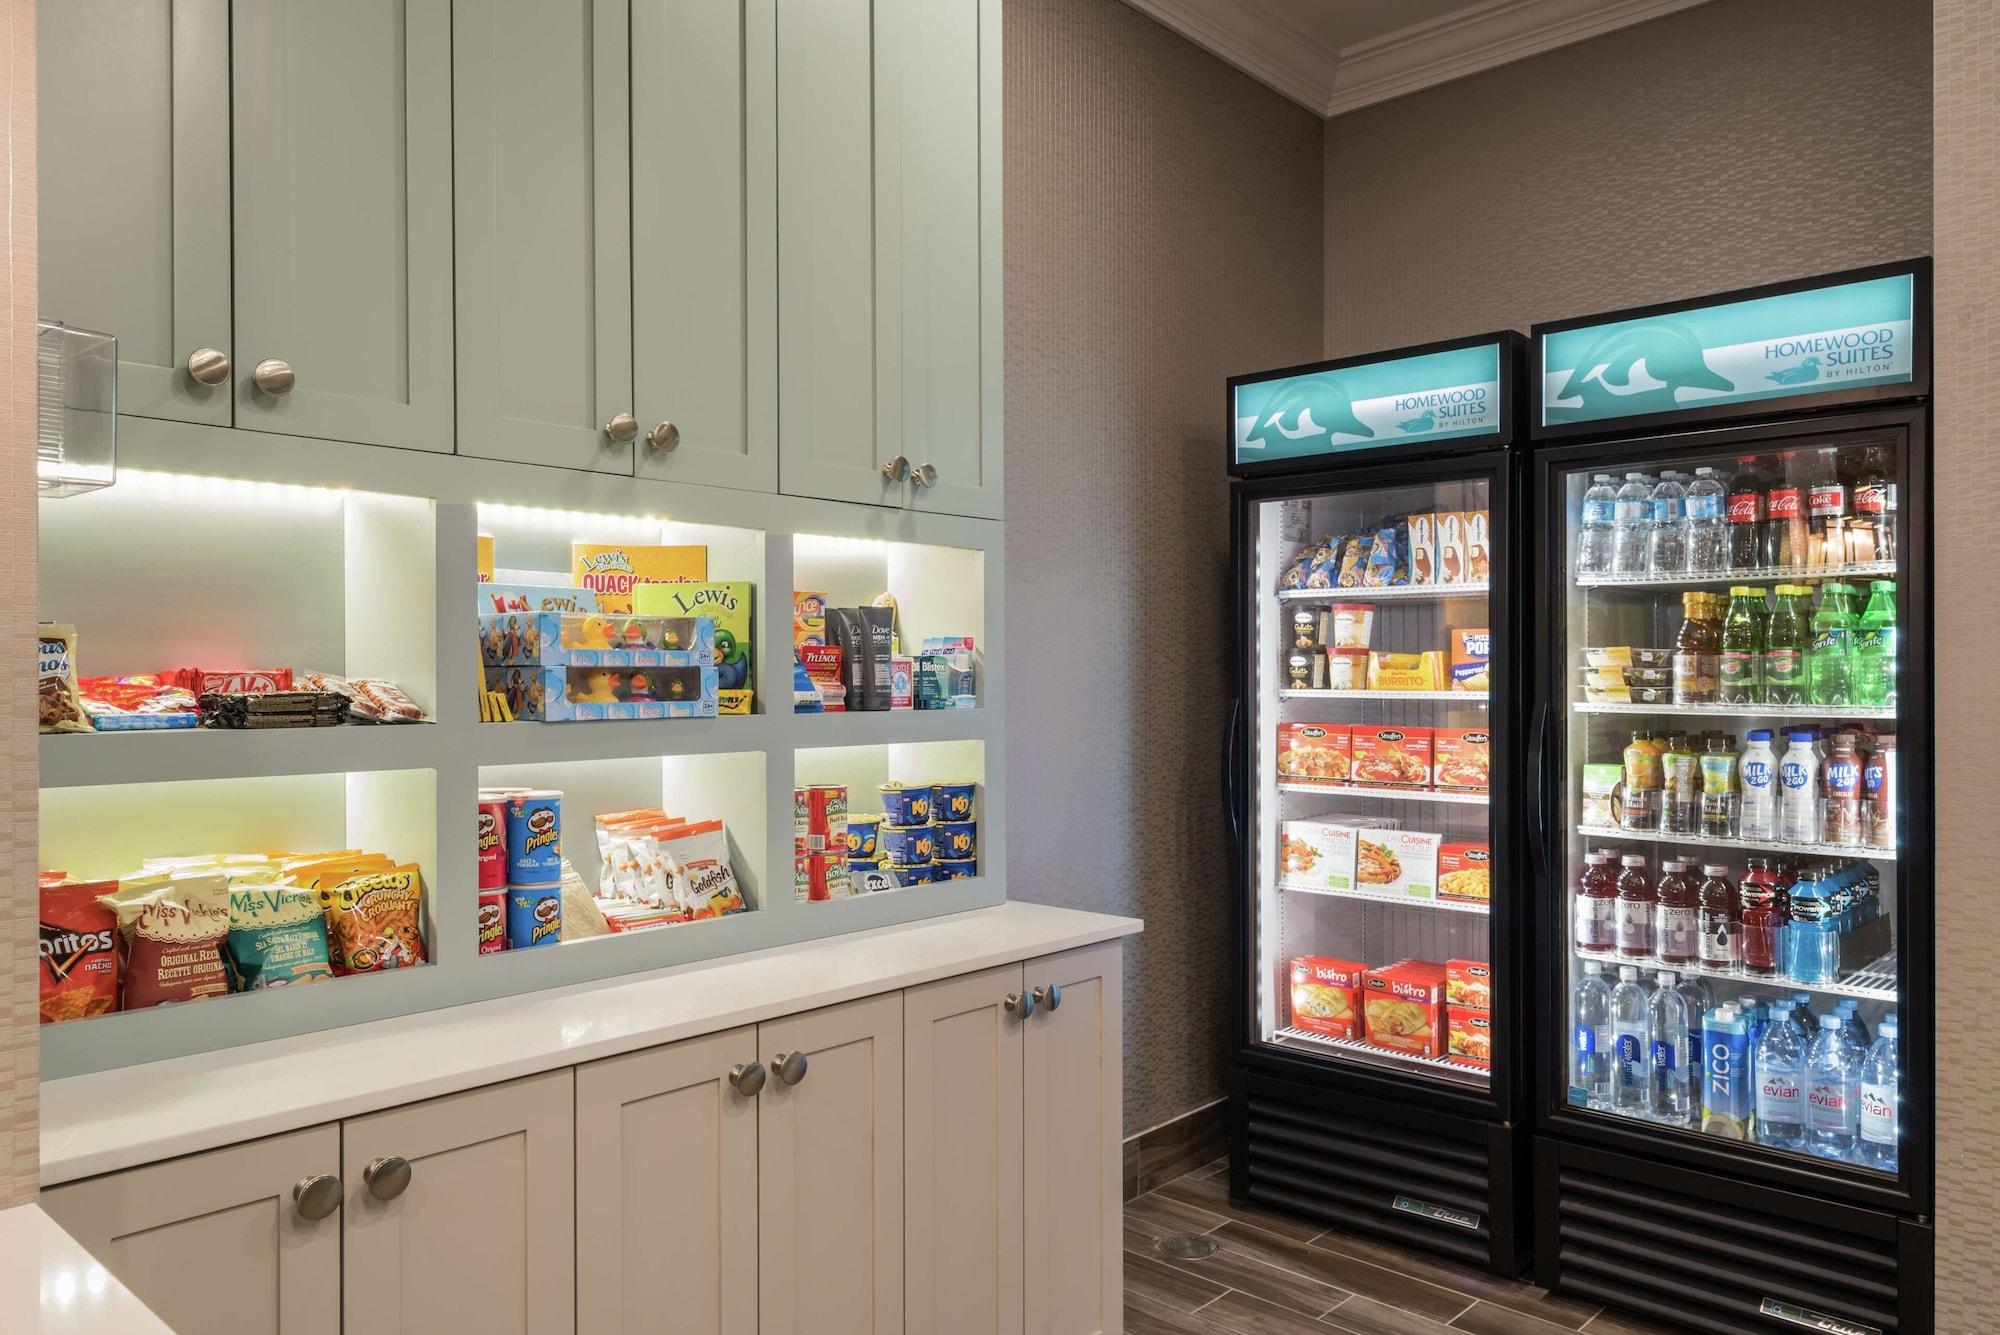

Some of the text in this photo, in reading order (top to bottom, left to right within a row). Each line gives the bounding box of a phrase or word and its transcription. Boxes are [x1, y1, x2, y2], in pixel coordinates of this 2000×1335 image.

[1765, 328, 1894, 360] HOMEWOOD
[1827, 344, 1894, 367] SUITES
[1826, 363, 1891, 378] BY HILTON
[1395, 388, 1486, 411] HOMEWOOD
[1439, 401, 1486, 419] SUITES
[1453, 416, 1483, 426] HILTON
[581, 548, 628, 572] Lewis
[672, 586, 738, 616] Lewis
[872, 624, 890, 634] Dove
[1813, 636, 1836, 653] Sprite
[1861, 634, 1884, 651] Sprite
[806, 652, 837, 663] TYLENOL
[922, 661, 945, 672] Blistex
[1377, 676, 1423, 686] BURRITO
[1744, 762, 1773, 778] MILK
[1782, 763, 1808, 778] MILK
[1826, 765, 1859, 780] MILK
[1750, 775, 1769, 785] 2GO
[1786, 776, 1804, 786] 2GO
[1836, 779, 1856, 788] 2GO
[525, 830, 559, 854] Pringles
[1322, 828, 1351, 842] CUISINE
[1401, 835, 1433, 846] CUISINE
[690, 865, 730, 894] Goldfish
[864, 874, 891, 890] excel
[362, 889, 414, 907] CRUNCHY
[361, 901, 415, 922] CROQUANT
[40, 931, 113, 957] oritos
[160, 949, 220, 968] ORIGINAL RECI
[157, 966, 192, 981] RECETTE
[1316, 967, 1347, 982] bistro
[1392, 981, 1425, 997] bistro
[1712, 1043, 1730, 1096] ZICO
[1763, 1084, 1800, 1098] evian
[1809, 1093, 1846, 1108] evian
